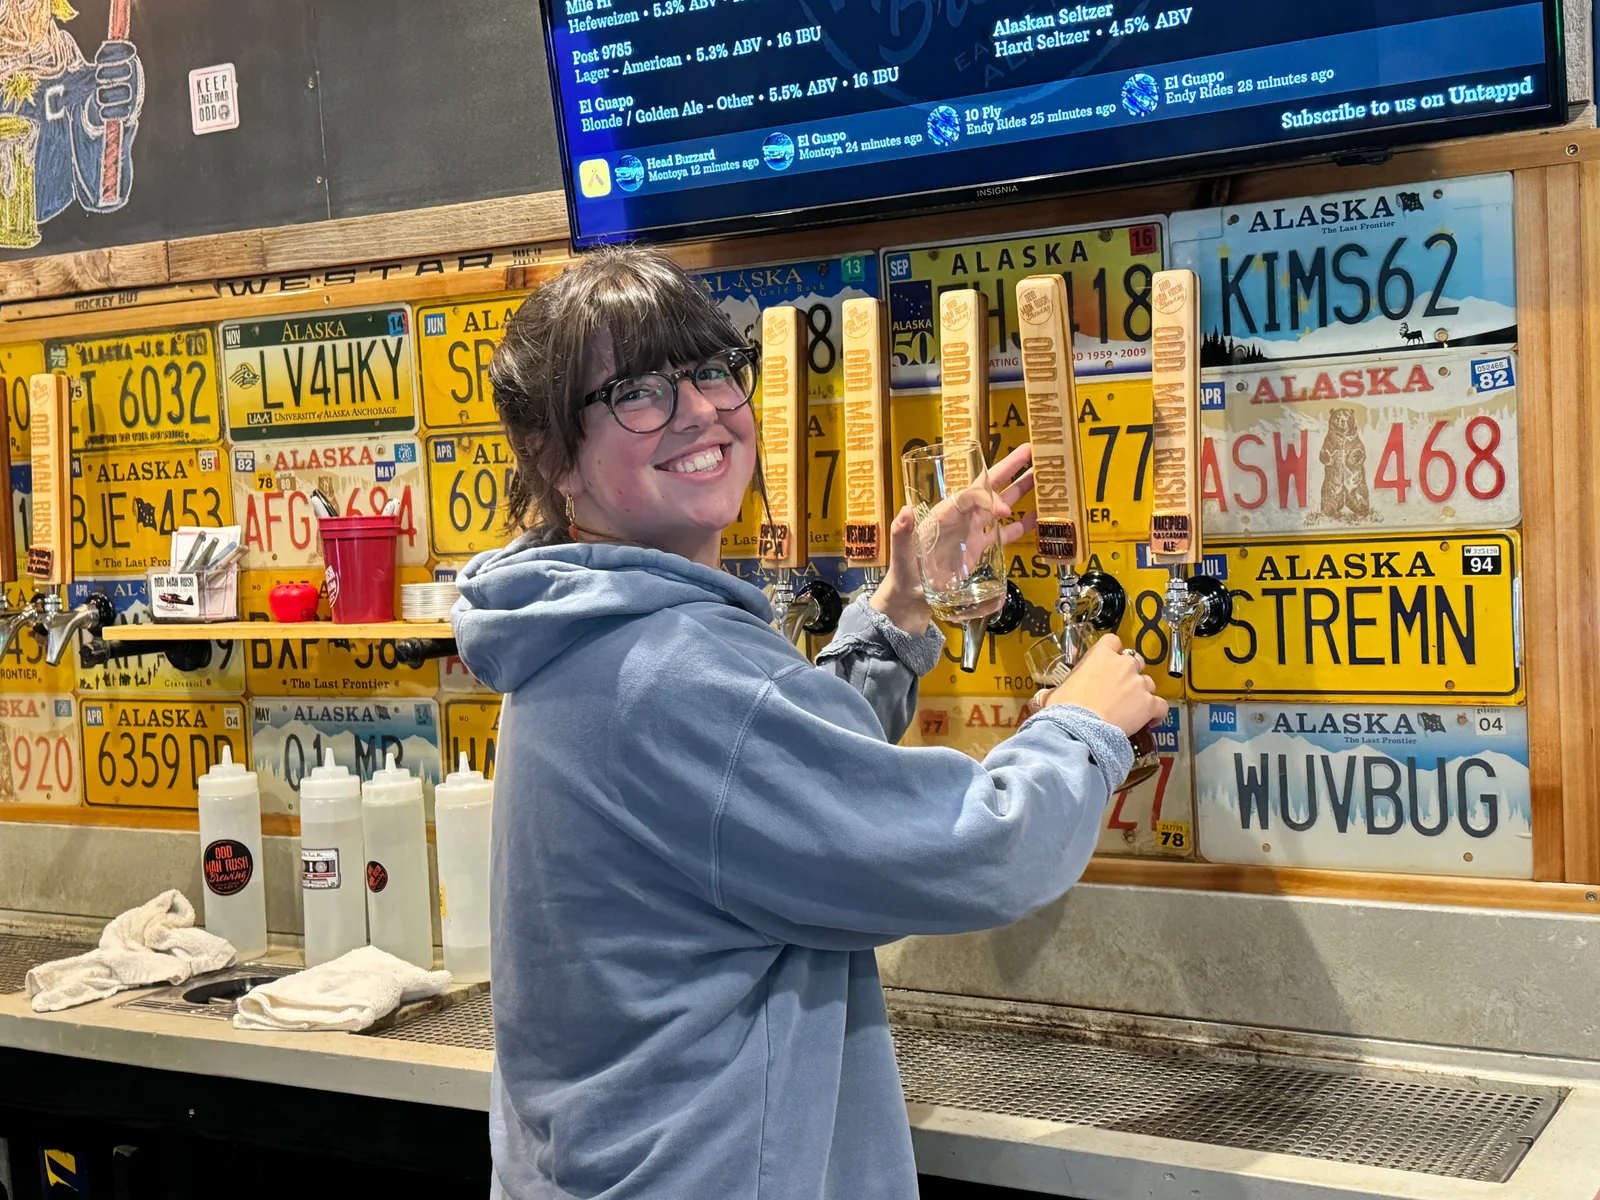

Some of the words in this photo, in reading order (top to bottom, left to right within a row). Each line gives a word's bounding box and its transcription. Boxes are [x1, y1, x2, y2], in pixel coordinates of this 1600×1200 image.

[566, 0, 594, 15] Mile
[569, 10, 640, 34] Hefeweizen
[653, 1, 685, 18] 5.3%
[992, 15, 1055, 37] Alaskan
[1058, 3, 1114, 26] Seltzer
[994, 34, 1034, 58] Hard
[1036, 29, 1091, 51] Seltzer
[1108, 16, 1150, 37] 4.5%
[1154, 7, 1193, 31] ABV
[572, 48, 599, 65] Post
[601, 41, 632, 60] 9785
[575, 60, 610, 84] Lager
[622, 53, 682, 76] American
[696, 43, 728, 63] 5.3%
[733, 37, 763, 57] ABV
[776, 32, 792, 49] 16
[795, 26, 822, 45] IBU
[196, 75, 227, 94] KEEP
[1164, 76, 1179, 90] El
[1182, 70, 1225, 89] Guapo
[1165, 89, 1197, 105] Endy
[1199, 83, 1233, 99] Rides
[1238, 79, 1254, 93] 28
[1257, 73, 1307, 89] minutes
[1311, 68, 1335, 83] ago
[579, 99, 592, 115] El
[595, 94, 634, 114] Guapo
[581, 114, 623, 132] Blonde
[635, 106, 679, 125] Golden
[682, 102, 704, 118] Ale
[717, 93, 754, 111] Other
[769, 84, 802, 103] 5.5%
[807, 77, 837, 97] ABV
[853, 72, 869, 88] 16
[872, 66, 900, 85] IBU
[1281, 104, 1366, 129] Subscribe
[1370, 100, 1390, 115] to
[1395, 98, 1416, 113] us
[1420, 94, 1445, 110] on
[1448, 76, 1533, 105] Untappd
[199, 105, 217, 121] ODD
[965, 109, 979, 122] 10
[981, 105, 1003, 122] Ply
[966, 121, 995, 137] Endy
[997, 115, 1027, 131] Rides
[1030, 112, 1045, 125] 25
[1047, 106, 1093, 123] minutes
[1096, 103, 1117, 119] ago
[797, 134, 809, 148] El
[810, 130, 847, 148] Guapo
[799, 145, 844, 161] Montoya
[845, 140, 859, 154] 24
[861, 136, 900, 152] minutes
[903, 133, 923, 148] ago
[647, 154, 673, 170] Head
[674, 149, 716, 166] Buzzard
[648, 168, 688, 183] Montoya
[690, 164, 702, 177] 12
[703, 160, 740, 175] minutes
[742, 158, 760, 171] ago
[976, 184, 1019, 197] INSIGNIA
[1248, 195, 1395, 233] ALASKA
[1131, 229, 1153, 247] 16
[1321, 226, 1337, 235] The
[1339, 224, 1358, 233] Last
[1361, 221, 1396, 232] Frontier
[845, 260, 861, 275] 13
[890, 260, 909, 276] SEP
[951, 240, 1089, 275] ALASKA
[700, 267, 803, 293] ALASKA
[759, 286, 789, 297] Gold
[797, 283, 825, 293] Rush
[1220, 232, 1460, 336] KIMS62
[75, 296, 114, 312] HOCKEY
[118, 292, 139, 304] HUT
[281, 320, 348, 343] ALASKA
[389, 314, 406, 334] 14
[426, 315, 444, 334] JUN
[892, 318, 932, 331] ALASKA
[226, 328, 241, 346] NOV
[892, 331, 936, 366] 50
[1087, 350, 1113, 360] 1959
[1120, 347, 1147, 358] 2009
[1153, 325, 1186, 373] ODD
[51, 356, 67, 366] 72
[942, 342, 971, 386] ODD
[1023, 337, 1058, 382] ODD
[259, 337, 403, 409] LV4HKY
[764, 355, 788, 397] ODD
[845, 349, 872, 392] ODD
[1479, 370, 1509, 389] 82
[120, 360, 211, 428] 6032
[1251, 364, 1434, 404] ALASKA
[248, 412, 271, 425] UAA
[274, 411, 316, 423] UNIVERSITY
[317, 410, 323, 421] of
[324, 408, 351, 420] ALASKA
[352, 406, 397, 418] ANCHORAGE
[943, 395, 972, 443] MAN
[1028, 393, 1064, 445] MAN
[1153, 382, 1187, 437] MAN
[846, 400, 874, 451] MAN
[201, 456, 213, 470] 95
[274, 446, 375, 471] ALASKA
[436, 445, 453, 460] APR
[97, 459, 188, 483] ALASKA
[237, 459, 253, 471] 82
[376, 465, 394, 478] MAY
[1201, 429, 1308, 512] ASW
[1374, 415, 1506, 504] 468
[258, 478, 273, 489] 78
[848, 460, 875, 517] RUSH
[1033, 455, 1069, 513] RUSH
[1154, 447, 1187, 510] RUSH
[72, 492, 130, 549] BJE
[160, 487, 224, 536] 453
[246, 490, 311, 553] AFG
[1163, 541, 1176, 553] ALE
[103, 558, 122, 568] The
[125, 557, 148, 568] Last
[1256, 551, 1435, 582] ALASKA
[1470, 557, 1494, 573] 94
[1223, 584, 1476, 666] STREMN
[291, 678, 311, 689] The
[315, 678, 340, 689] Last
[342, 677, 390, 689] Frontier
[86, 708, 103, 724] APR
[117, 708, 208, 728] ALASKA
[226, 716, 238, 727] 04
[255, 707, 270, 722] MAY
[294, 705, 375, 723] ALASKA
[415, 705, 430, 719] 14
[1210, 710, 1235, 725] AUG
[1271, 712, 1416, 735] ALASKA
[1479, 717, 1503, 731] 04
[1344, 736, 1359, 744] The
[1361, 736, 1379, 744] Last
[1382, 736, 1417, 745] Frontier
[14, 735, 73, 793] 920
[99, 732, 180, 789] 6359
[1234, 752, 1499, 839] WUVBUG
[1161, 833, 1184, 847] 78
[215, 845, 233, 860] ODD
[205, 860, 222, 873] MAN
[225, 856, 249, 872] RUSH
